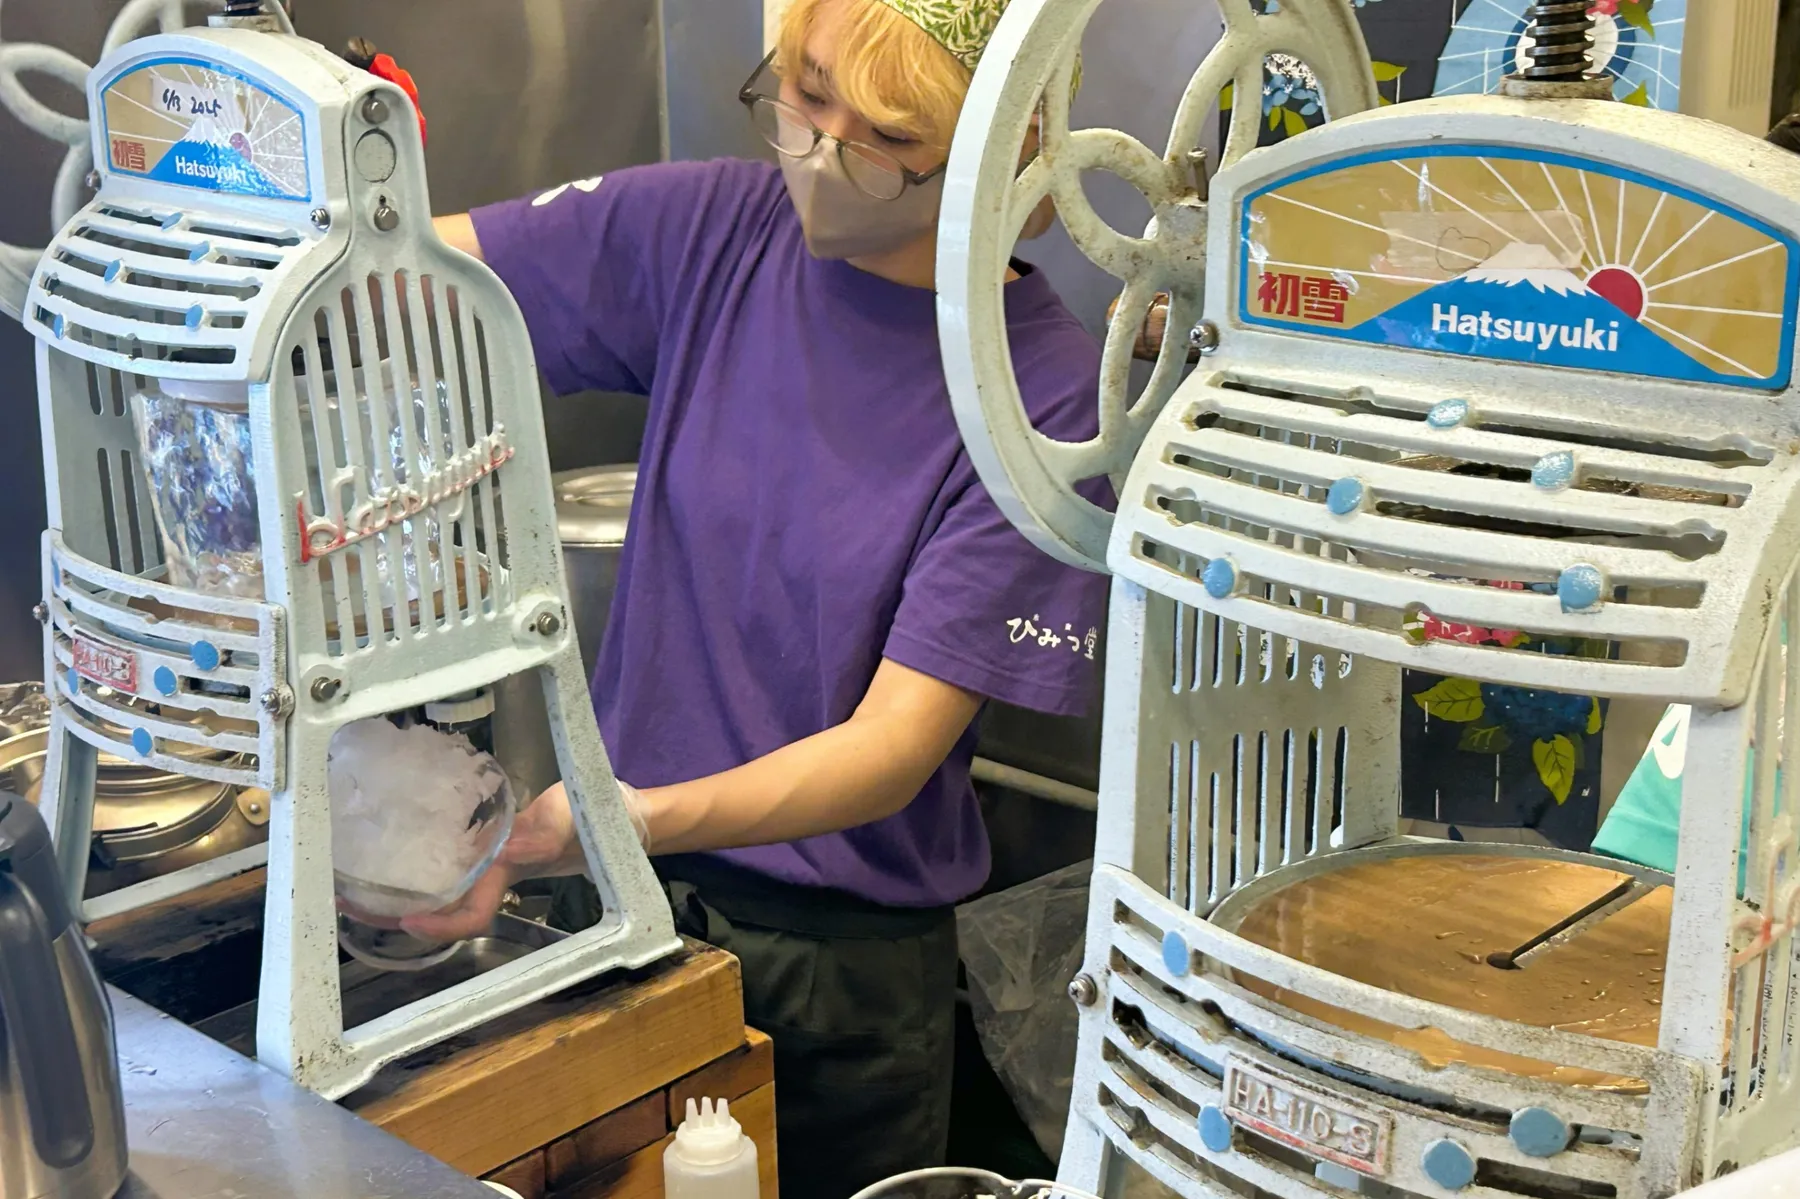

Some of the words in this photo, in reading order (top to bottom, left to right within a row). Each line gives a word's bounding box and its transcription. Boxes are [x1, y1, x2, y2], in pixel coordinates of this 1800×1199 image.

[112, 139, 146, 172] 初雪
[175, 154, 250, 187] Hatsuyuki
[1258, 271, 1349, 323] 初雪
[1432, 302, 1619, 352] Hatsuyuki
[1235, 1071, 1373, 1155] HA-110-S
